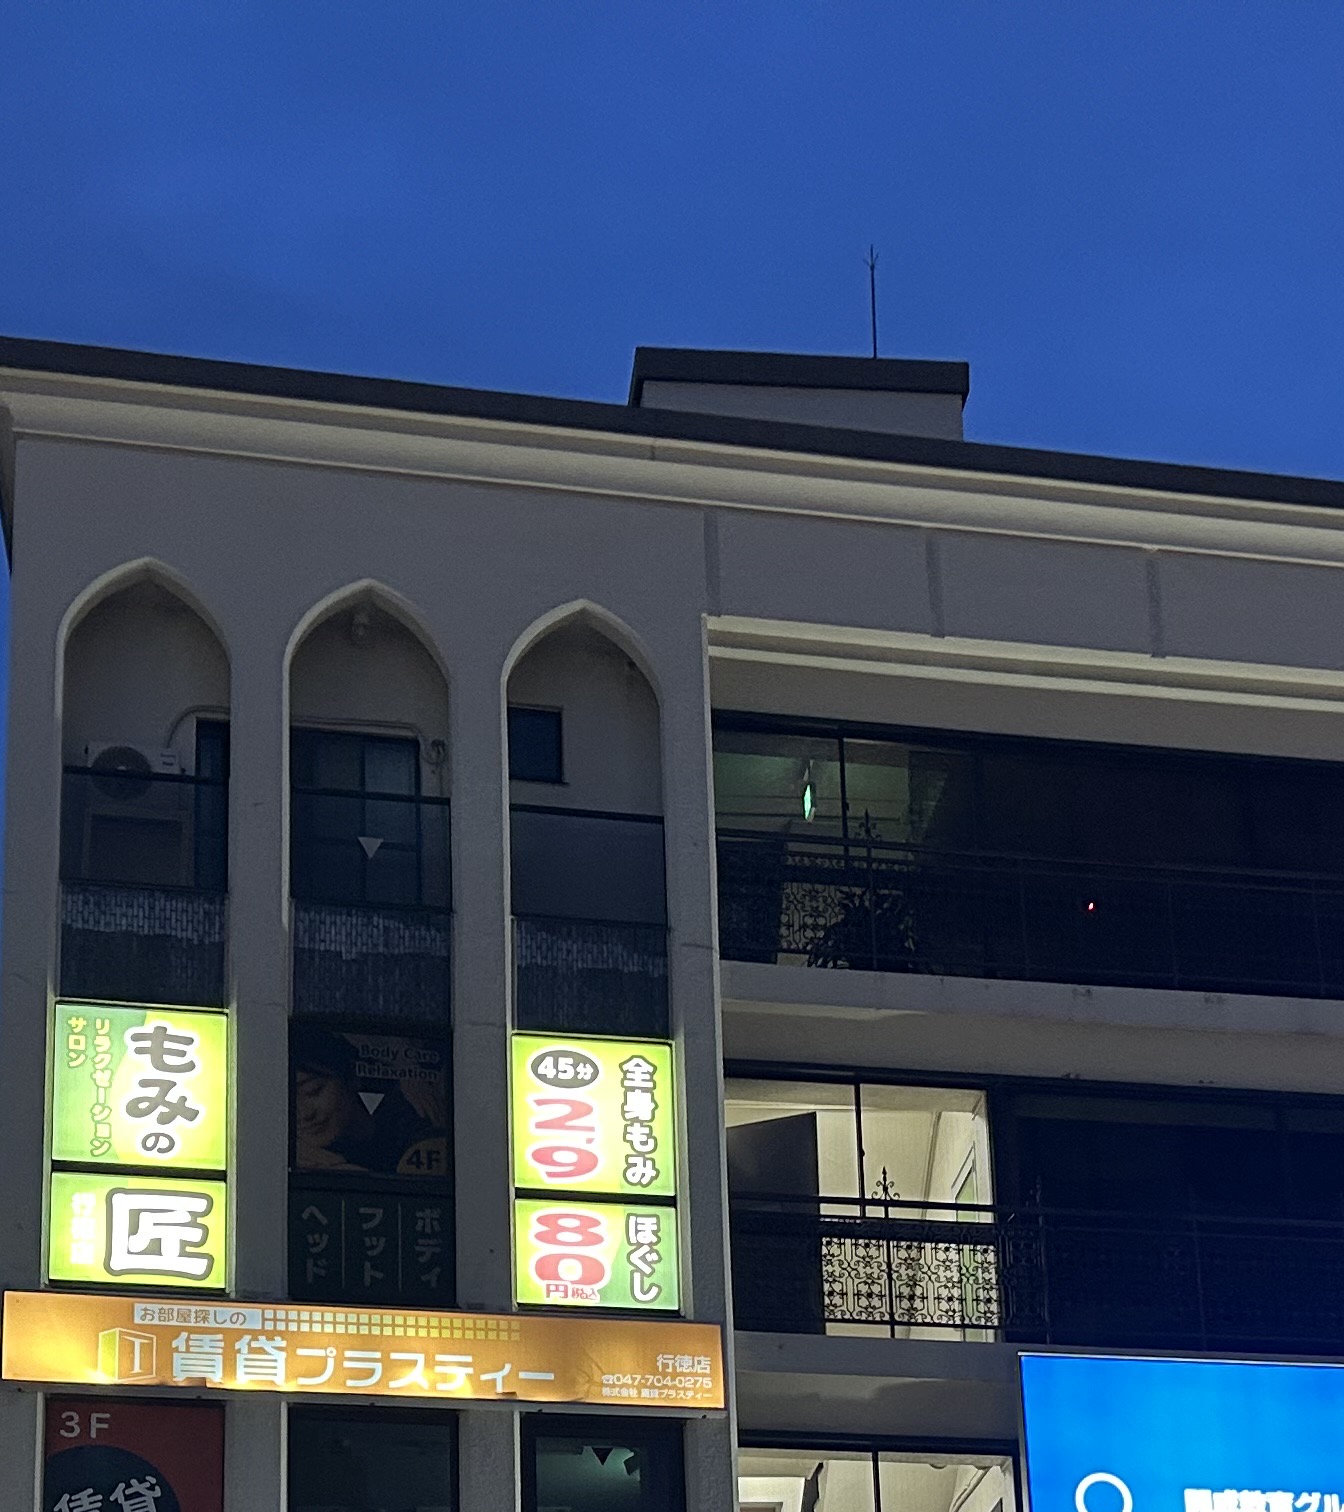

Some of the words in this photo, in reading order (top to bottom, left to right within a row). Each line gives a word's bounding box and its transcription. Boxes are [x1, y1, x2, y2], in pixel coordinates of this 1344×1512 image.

[67, 1016, 89, 1069] サロン
[360, 1044, 398, 1062] Body
[403, 1047, 441, 1063] Care
[537, 1057, 594, 1081] 45分
[90, 1018, 113, 1158] リラクゼーション
[125, 1025, 200, 1154] もみの
[356, 1061, 438, 1081] Relaxation
[406, 1149, 442, 1170] 4F
[105, 1188, 214, 1281] 匠
[301, 1205, 330, 1285] ヘッド
[358, 1207, 386, 1288] フット
[415, 1207, 443, 1289] ボディ
[626, 1212, 662, 1304] ほぐし
[139, 1306, 247, 1326] お部屋探しの
[172, 1331, 555, 1394] 賃貸プラスティー
[614, 1374, 712, 1389] 047-704-0275
[657, 1354, 712, 1374] 行徳店
[60, 1412, 111, 1439] 3F
